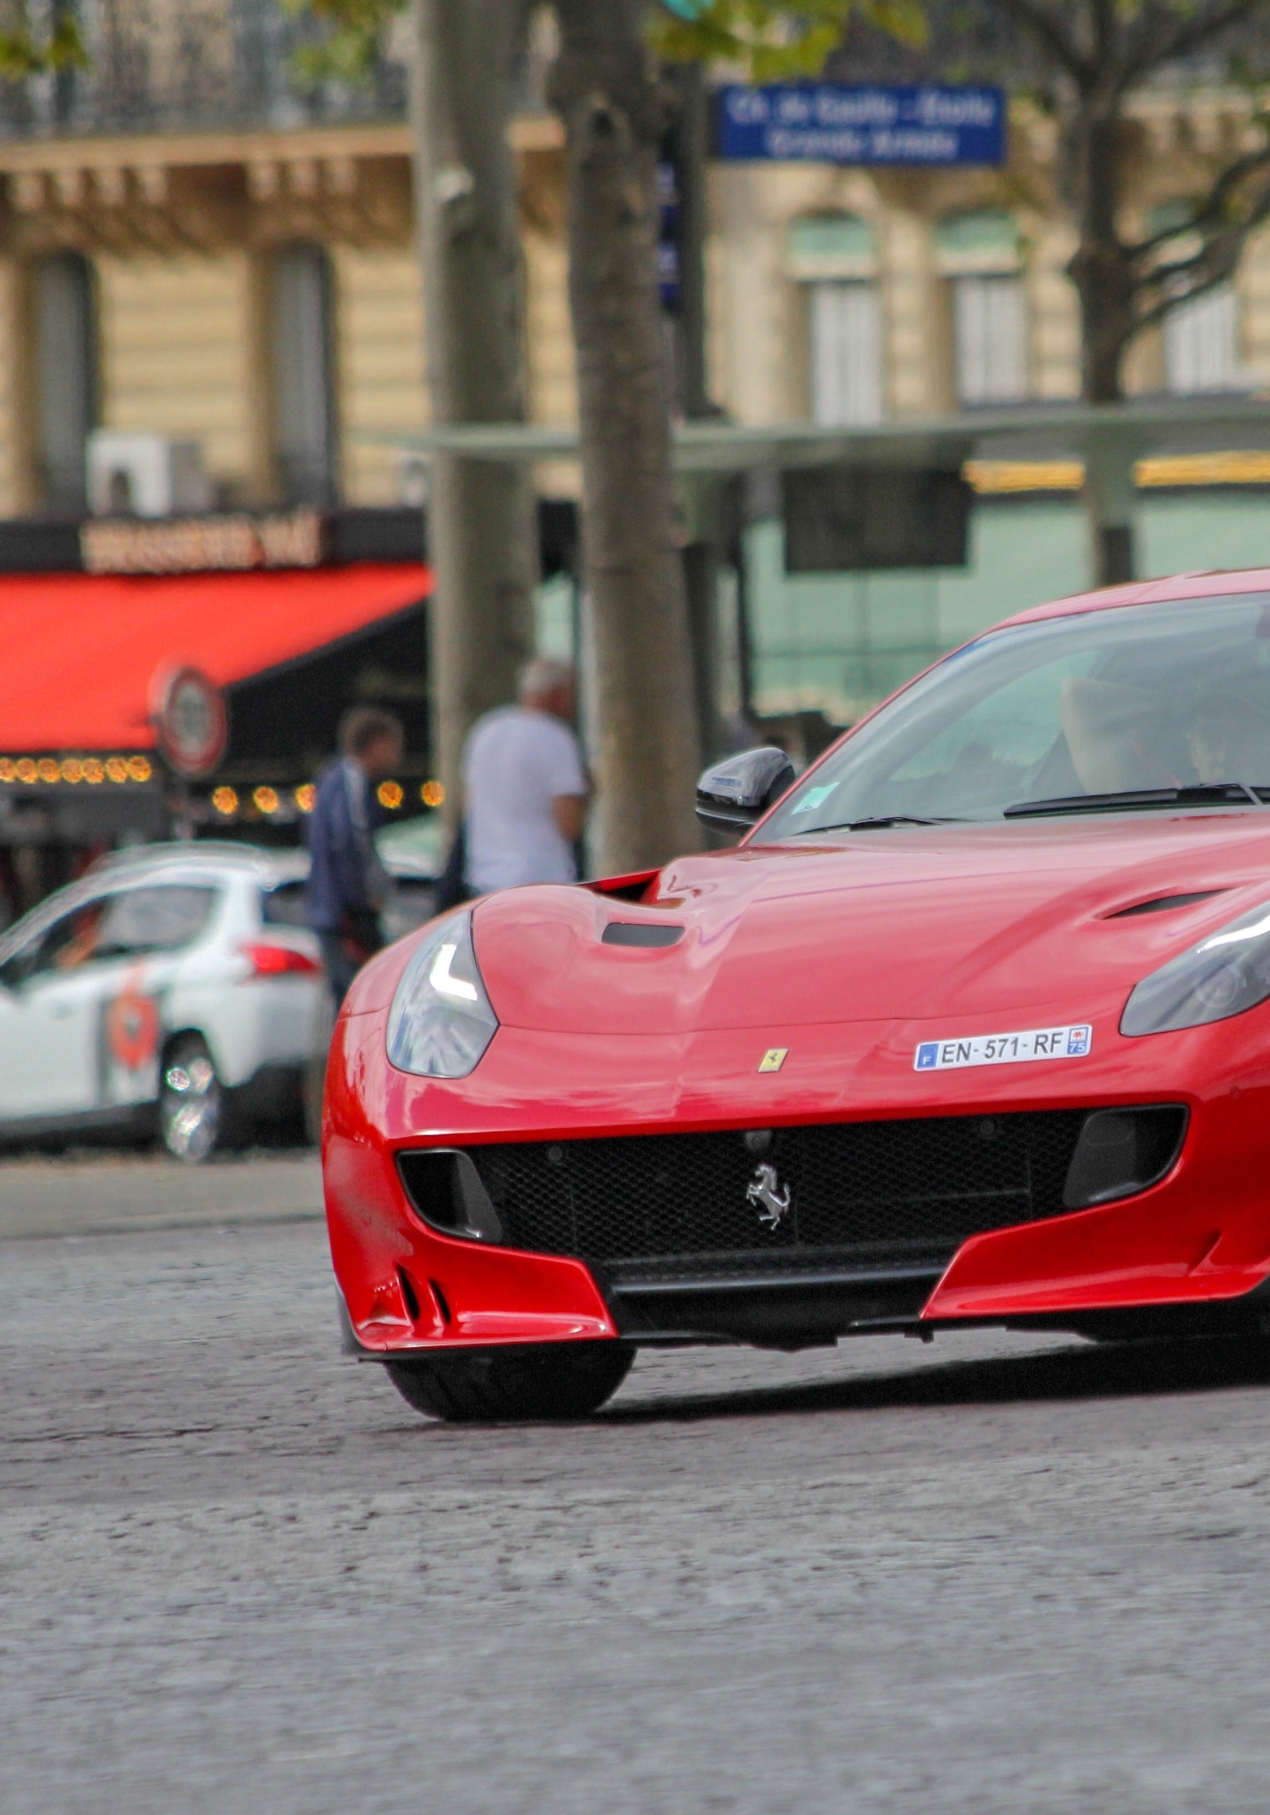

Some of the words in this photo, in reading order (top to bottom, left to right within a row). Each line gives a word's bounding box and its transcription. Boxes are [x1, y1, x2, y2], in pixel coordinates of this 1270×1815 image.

[814, 87, 899, 124] Gaulle
[922, 1056, 932, 1066] F
[1069, 1042, 1086, 1053] 75
